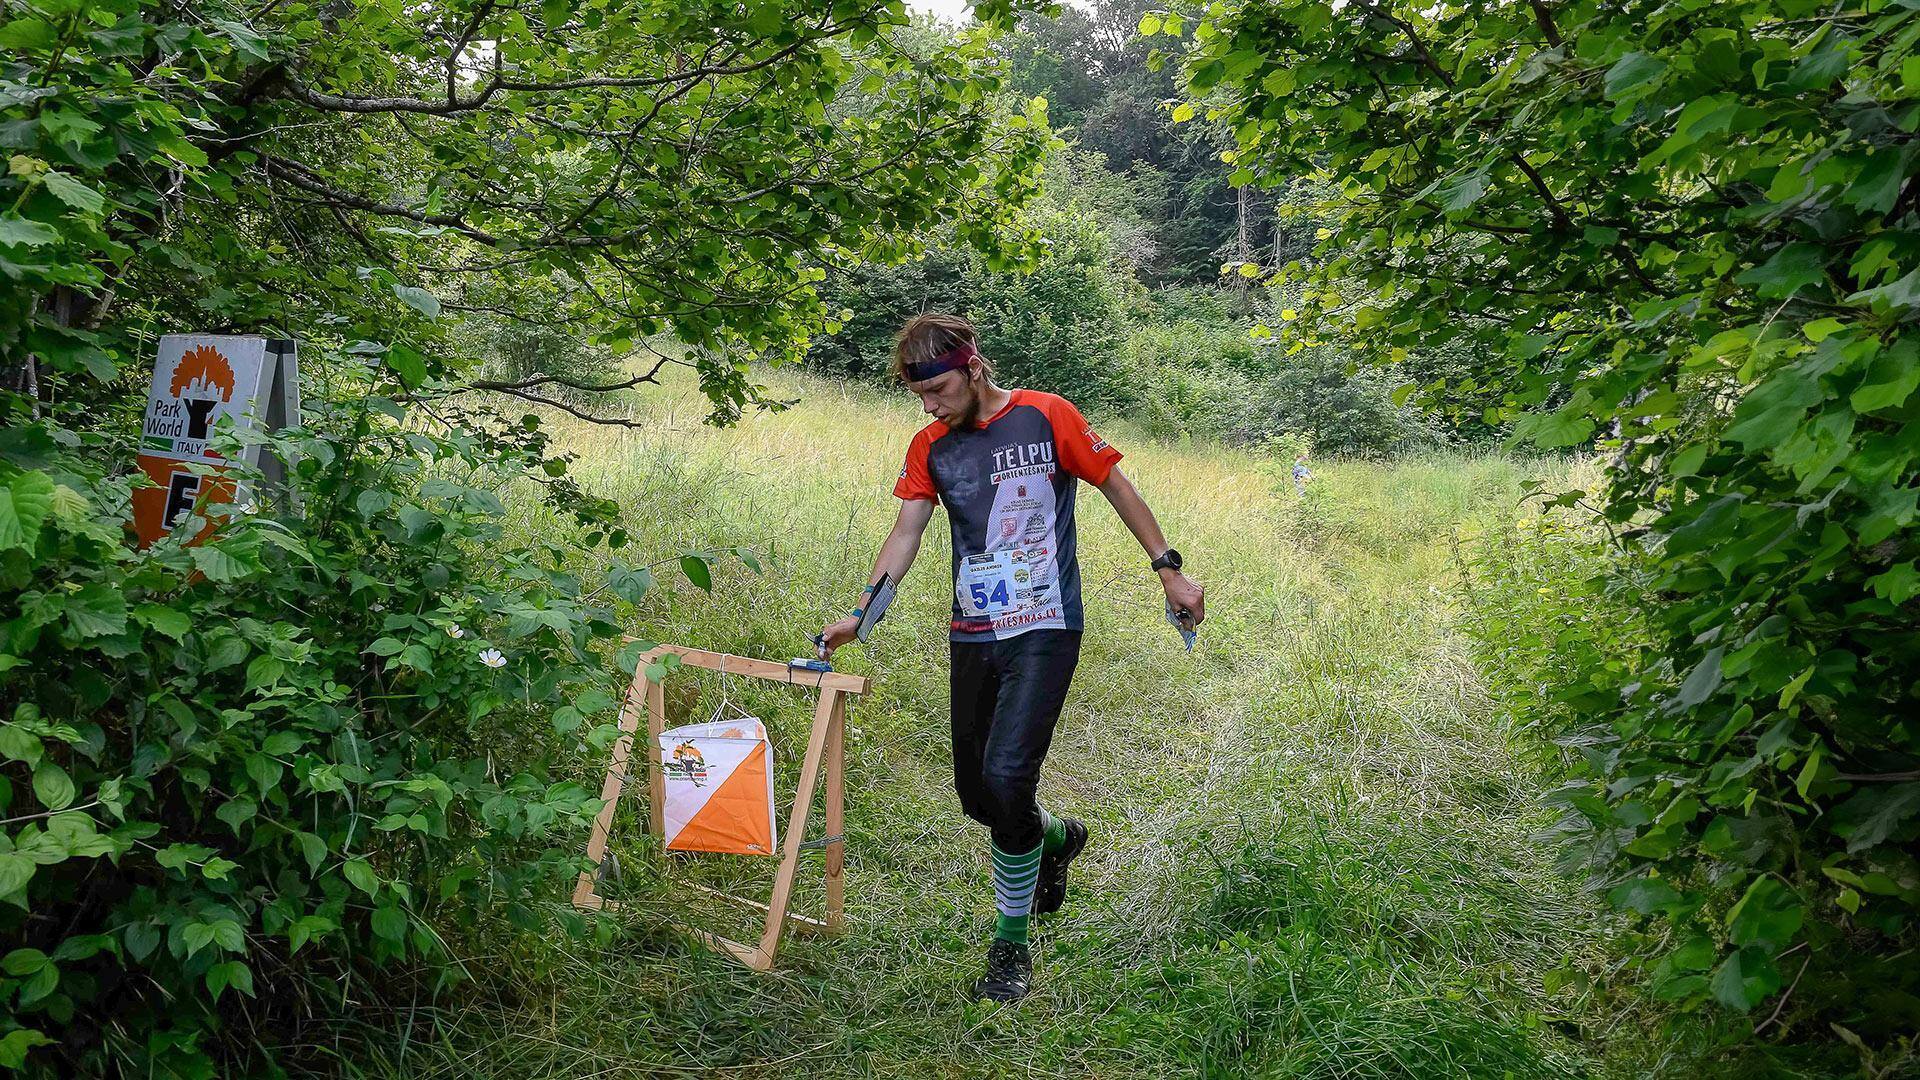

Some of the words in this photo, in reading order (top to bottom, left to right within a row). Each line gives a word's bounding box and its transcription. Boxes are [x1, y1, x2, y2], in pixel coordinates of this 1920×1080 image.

[155, 399, 181, 418] Park
[147, 417, 184, 437] World
[176, 441, 202, 455] ITALY
[992, 441, 1053, 471] TELPU
[970, 579, 1009, 610] 54
